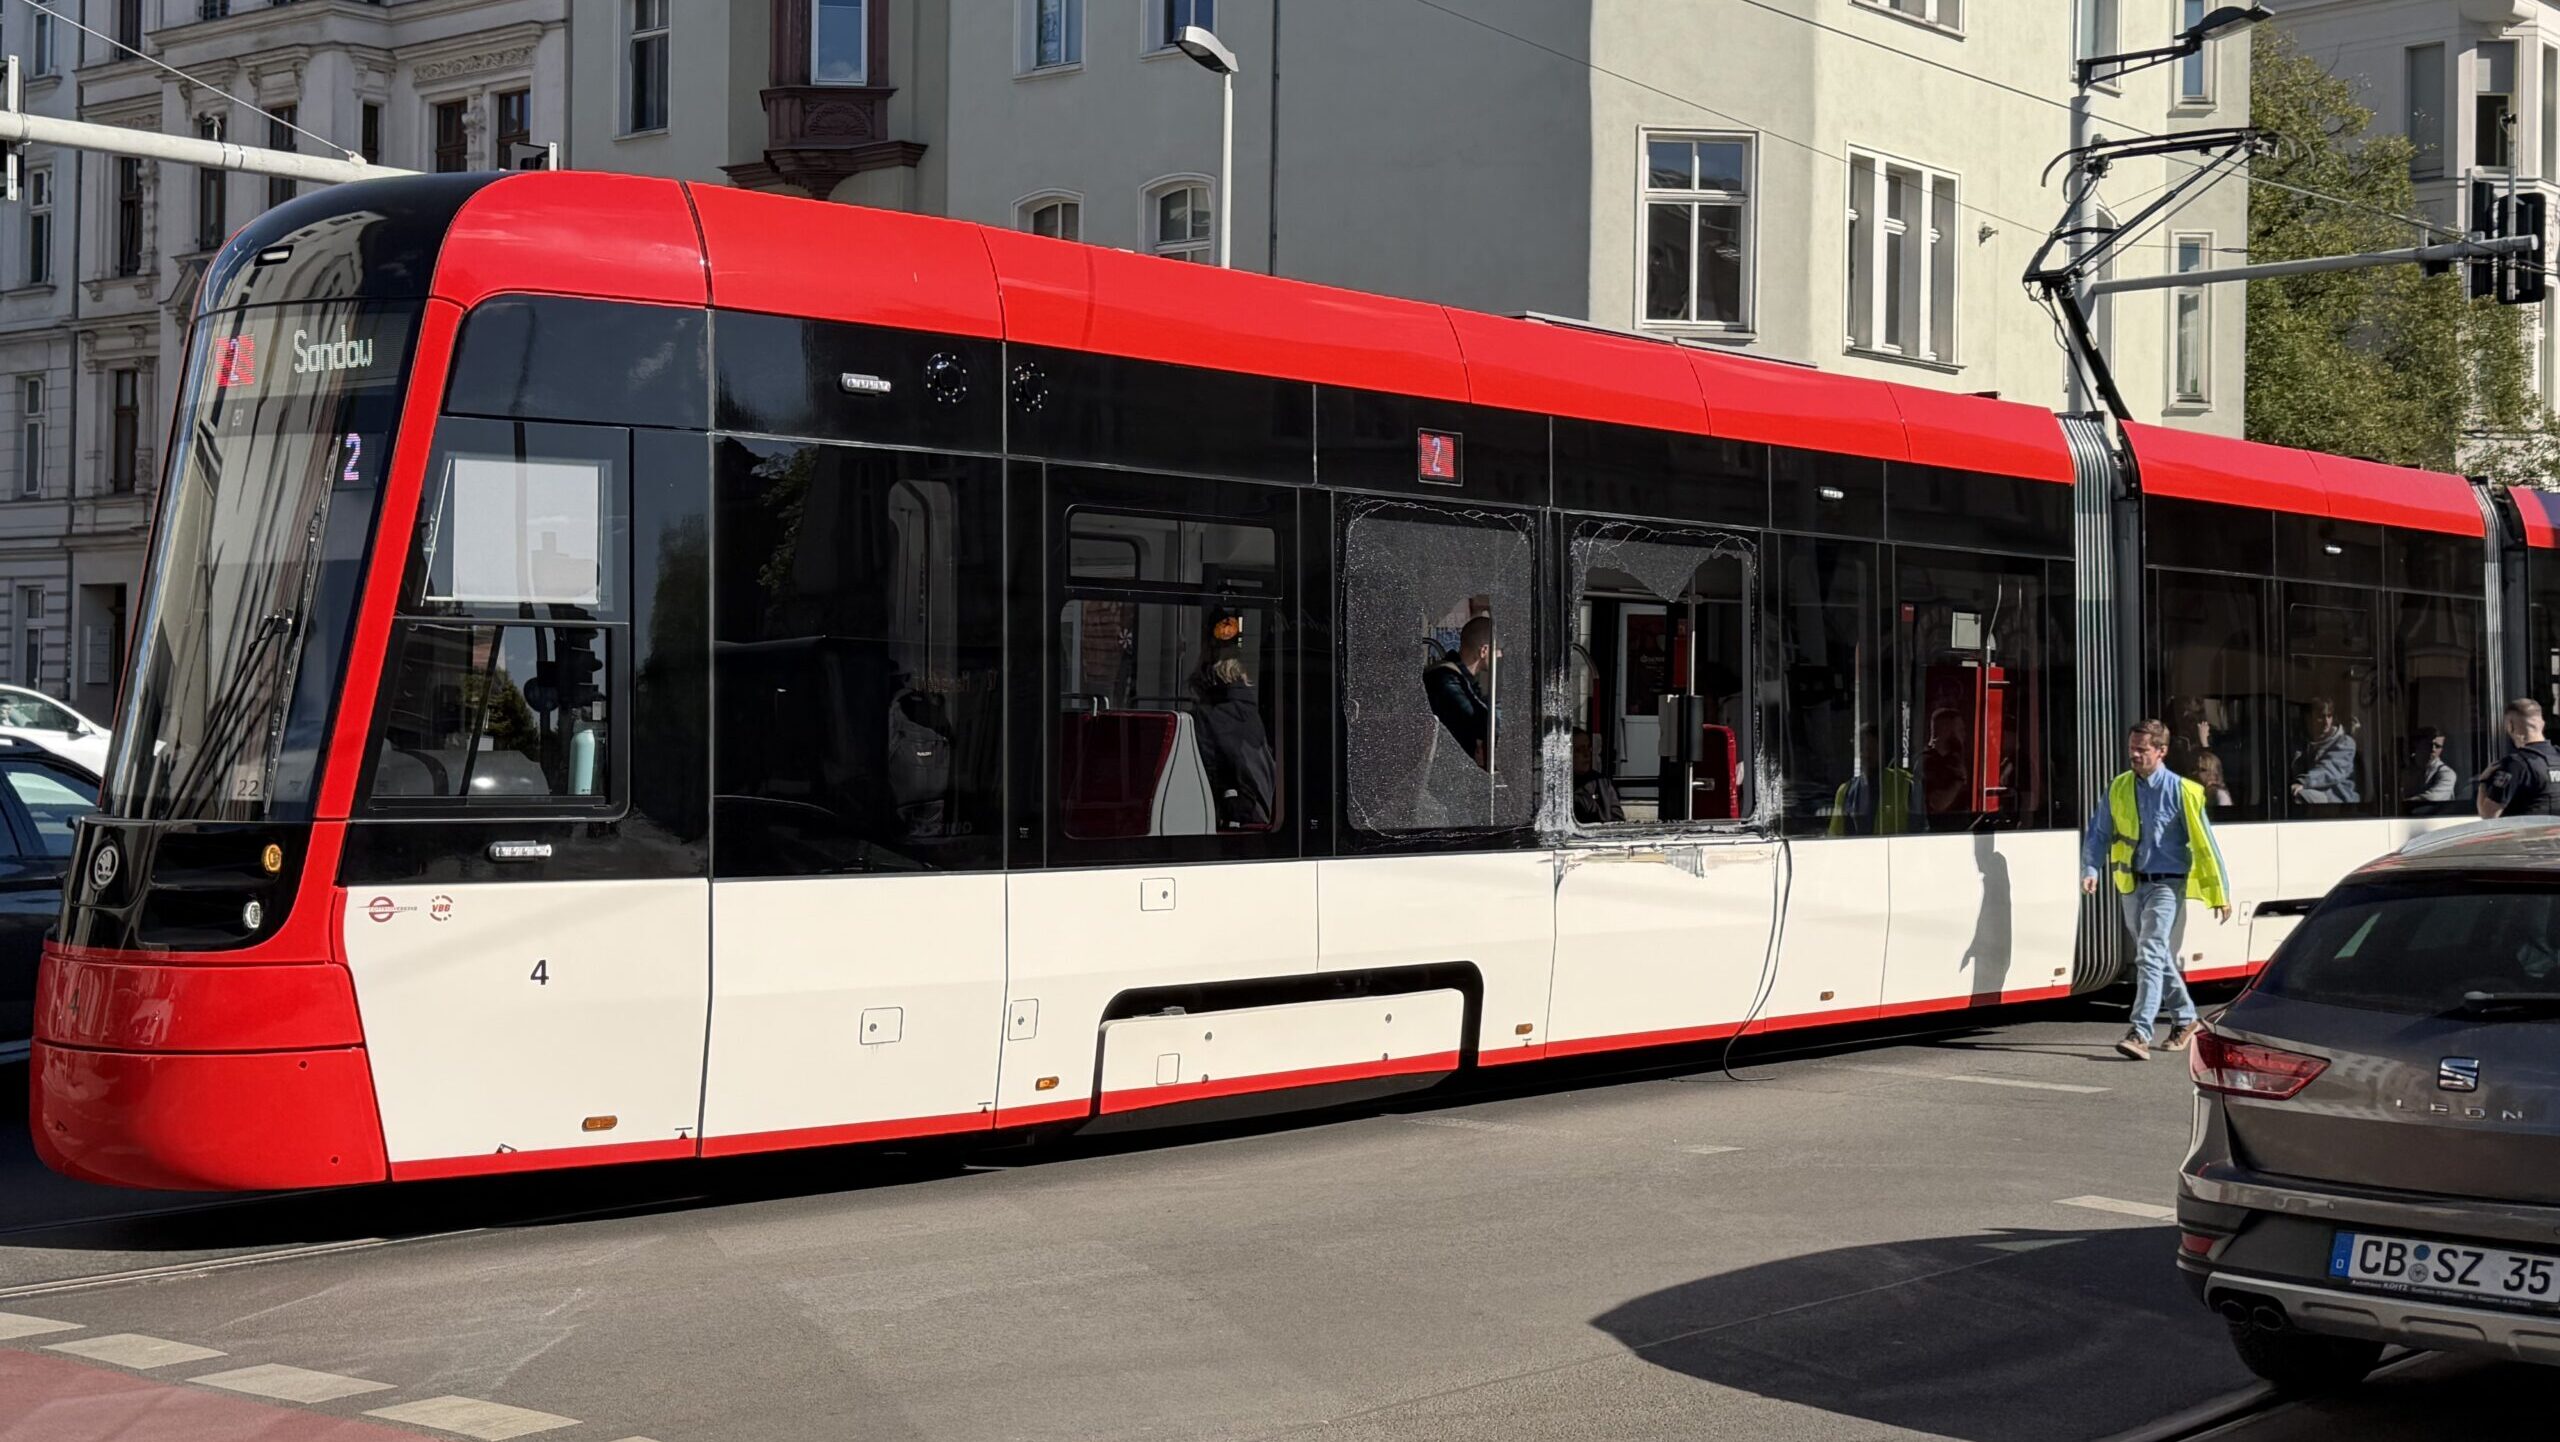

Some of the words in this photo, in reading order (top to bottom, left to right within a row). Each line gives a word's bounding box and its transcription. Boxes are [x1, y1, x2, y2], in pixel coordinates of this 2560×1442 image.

[229, 338, 240, 382] 2
[293, 324, 373, 374] Sandow
[343, 433, 361, 481] 2
[1432, 437, 1441, 472] 2
[237, 780, 259, 797] 22
[432, 904, 451, 913] VBB
[530, 959, 549, 985] 4
[2396, 1099, 2524, 1121] LEON
[2335, 1258, 2344, 1270] D
[2359, 1239, 2408, 1277] CB
[2433, 1248, 2485, 1287] SZ
[2503, 1256, 2554, 1295] 35
